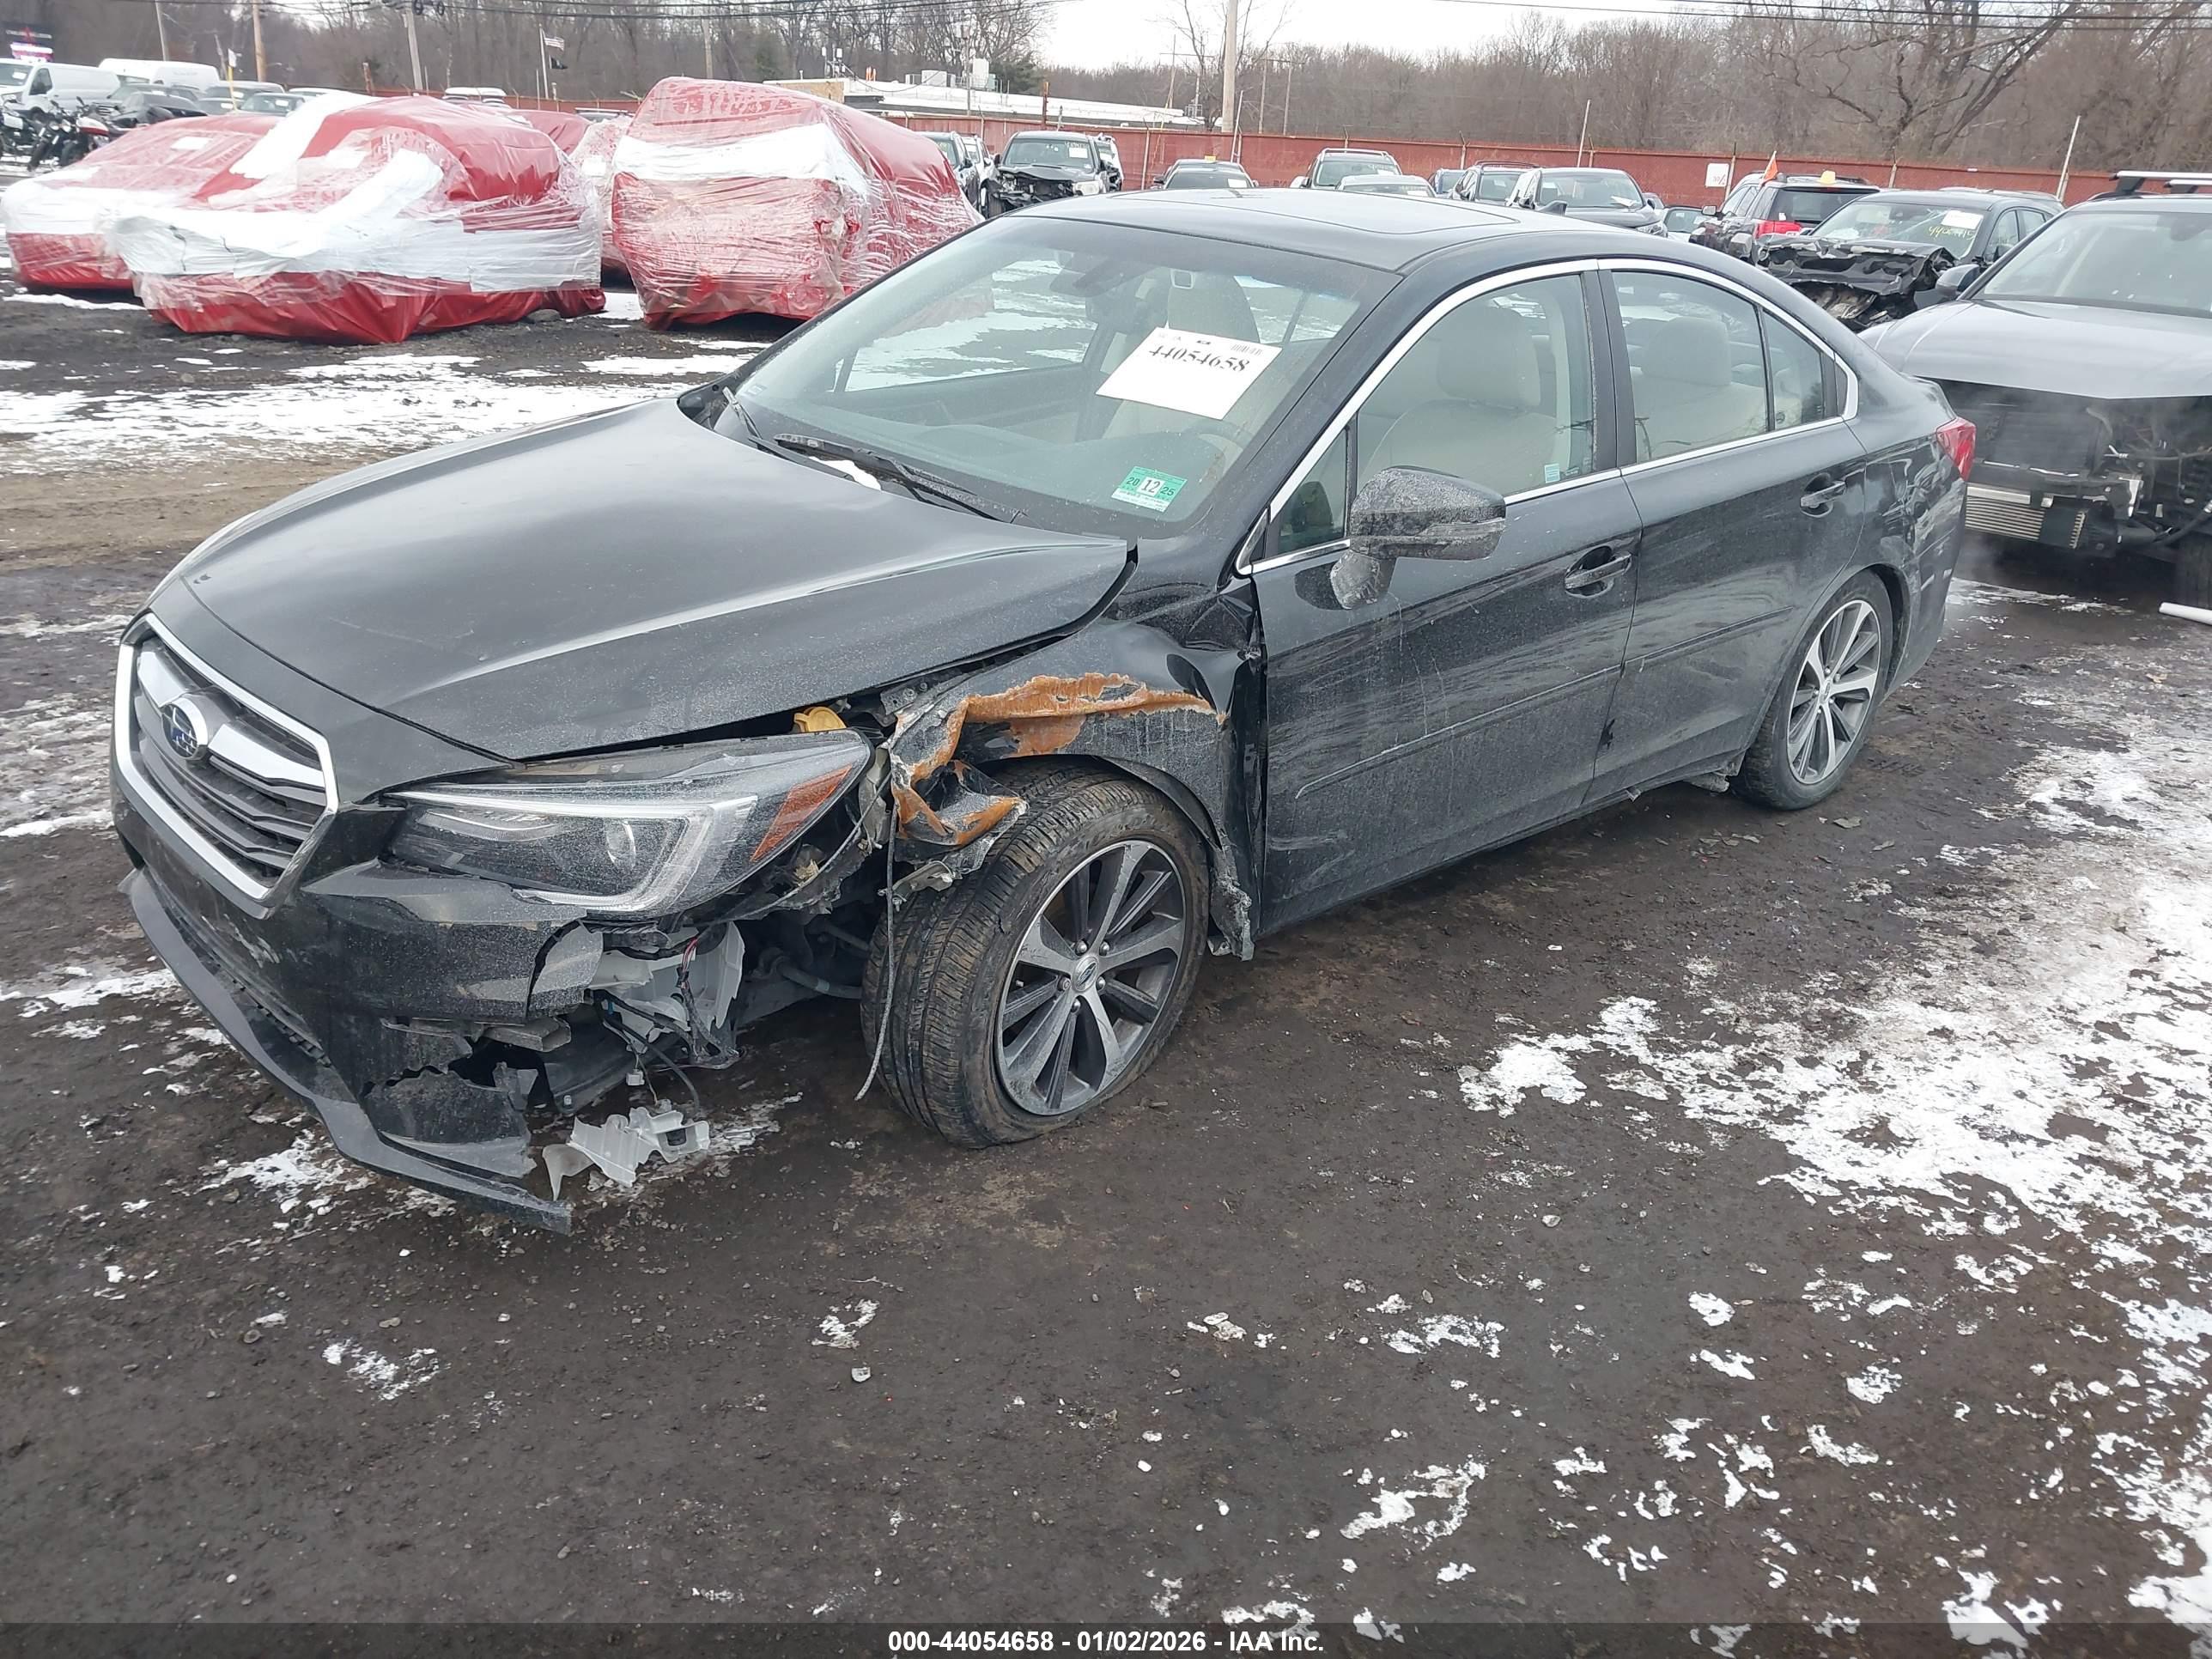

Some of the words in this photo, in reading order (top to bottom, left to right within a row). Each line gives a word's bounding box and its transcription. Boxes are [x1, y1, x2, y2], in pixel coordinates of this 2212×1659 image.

[1149, 344, 1250, 372] 44054658
[1141, 479, 1161, 494] 12
[1160, 486, 1176, 496] 25
